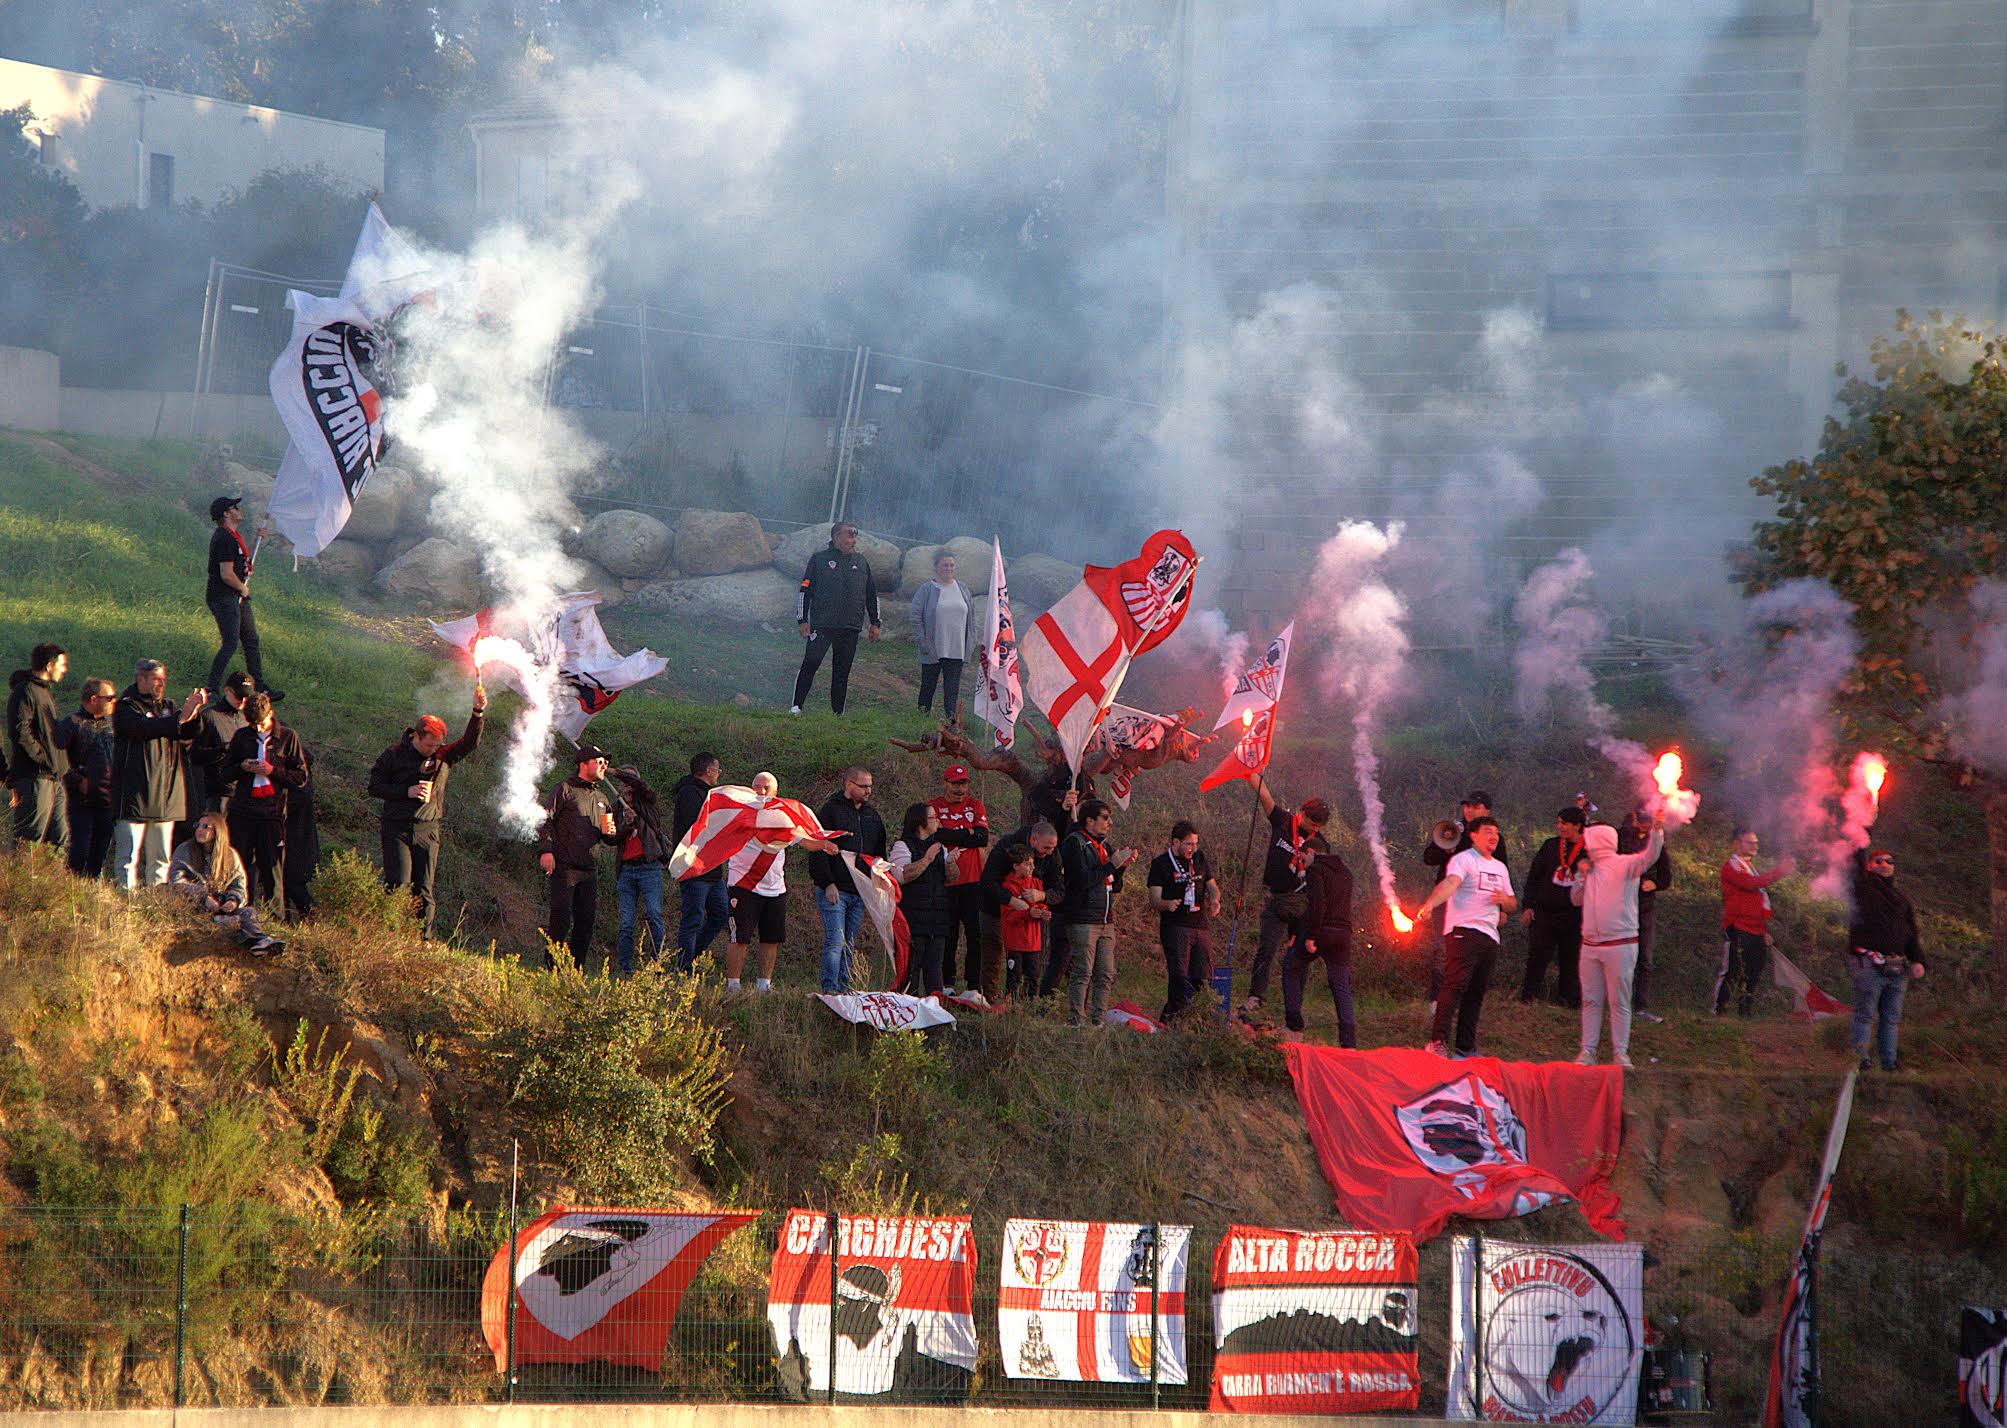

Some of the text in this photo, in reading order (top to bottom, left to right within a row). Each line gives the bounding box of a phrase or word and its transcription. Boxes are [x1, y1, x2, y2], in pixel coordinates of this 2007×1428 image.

[1227, 1235, 1396, 1273] ALTA ROCCA
[1491, 1258, 1596, 1297] CULLETTIVU
[1100, 1292, 1137, 1312] FANS
[1350, 1372, 1413, 1393] ROSSA
